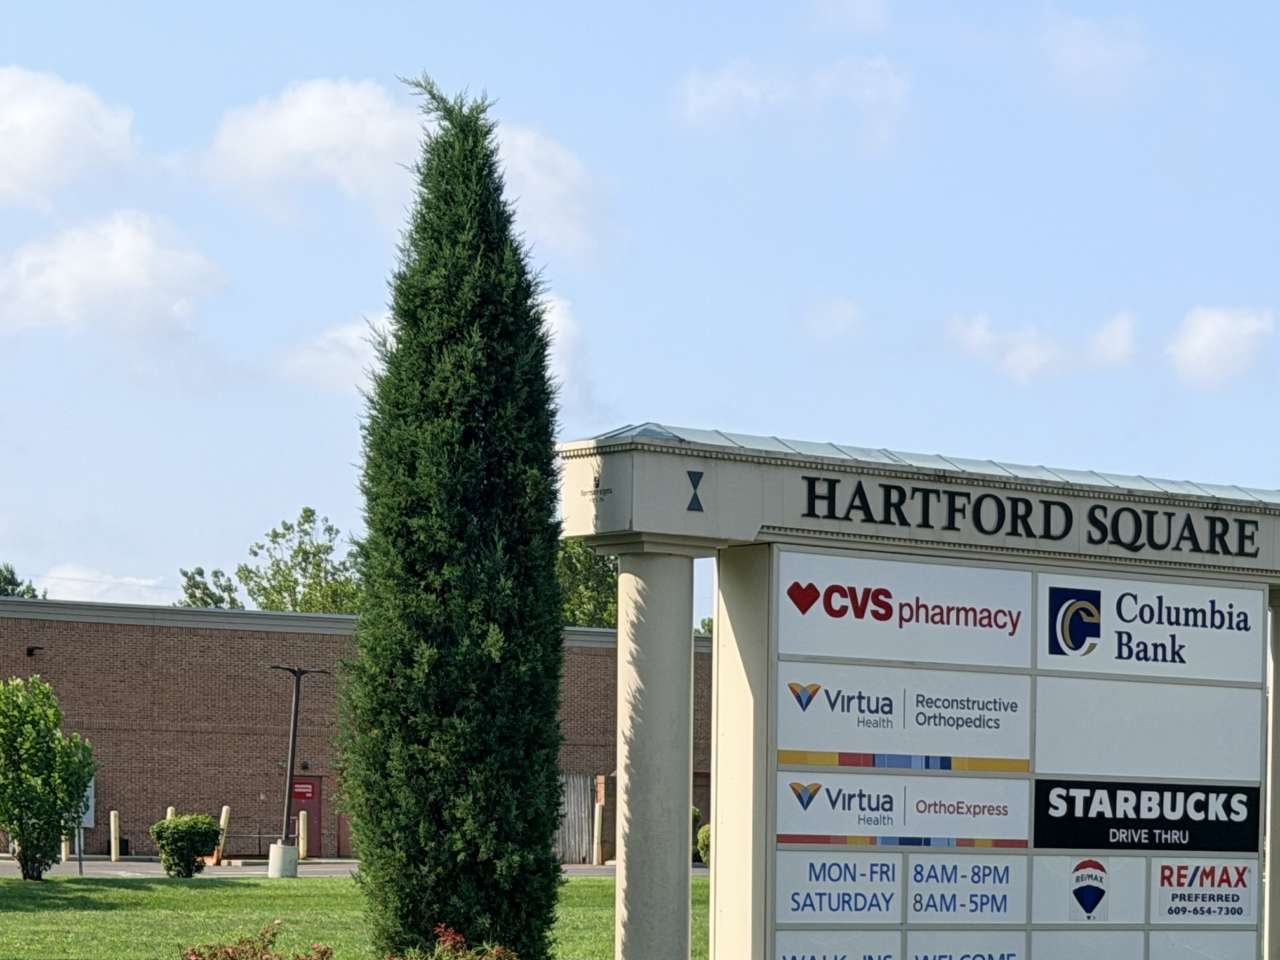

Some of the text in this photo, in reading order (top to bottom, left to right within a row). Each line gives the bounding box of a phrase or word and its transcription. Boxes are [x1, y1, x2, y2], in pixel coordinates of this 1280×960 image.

[801, 475, 1261, 559] HARTFORD SQUARE
[822, 584, 1021, 636] CVS pharmacy
[1115, 591, 1252, 633] Columbia
[1115, 631, 1186, 664] Bank
[824, 689, 893, 715] Virtua
[916, 694, 1018, 715] Reconstructive
[857, 716, 894, 729] Health
[915, 711, 1001, 731] Orthopedics
[825, 788, 893, 812] Virtua
[916, 800, 1008, 817] OrthoExpress
[1048, 787, 1249, 823] STARBUCKS
[857, 815, 894, 826] Health
[1109, 828, 1189, 845] DRIVE THRU
[1161, 864, 1247, 888] RE/MAX
[791, 892, 894, 912] SATURDAY
[1169, 891, 1240, 904] PREFERRED
[1167, 906, 1244, 917] 609-654-7300
